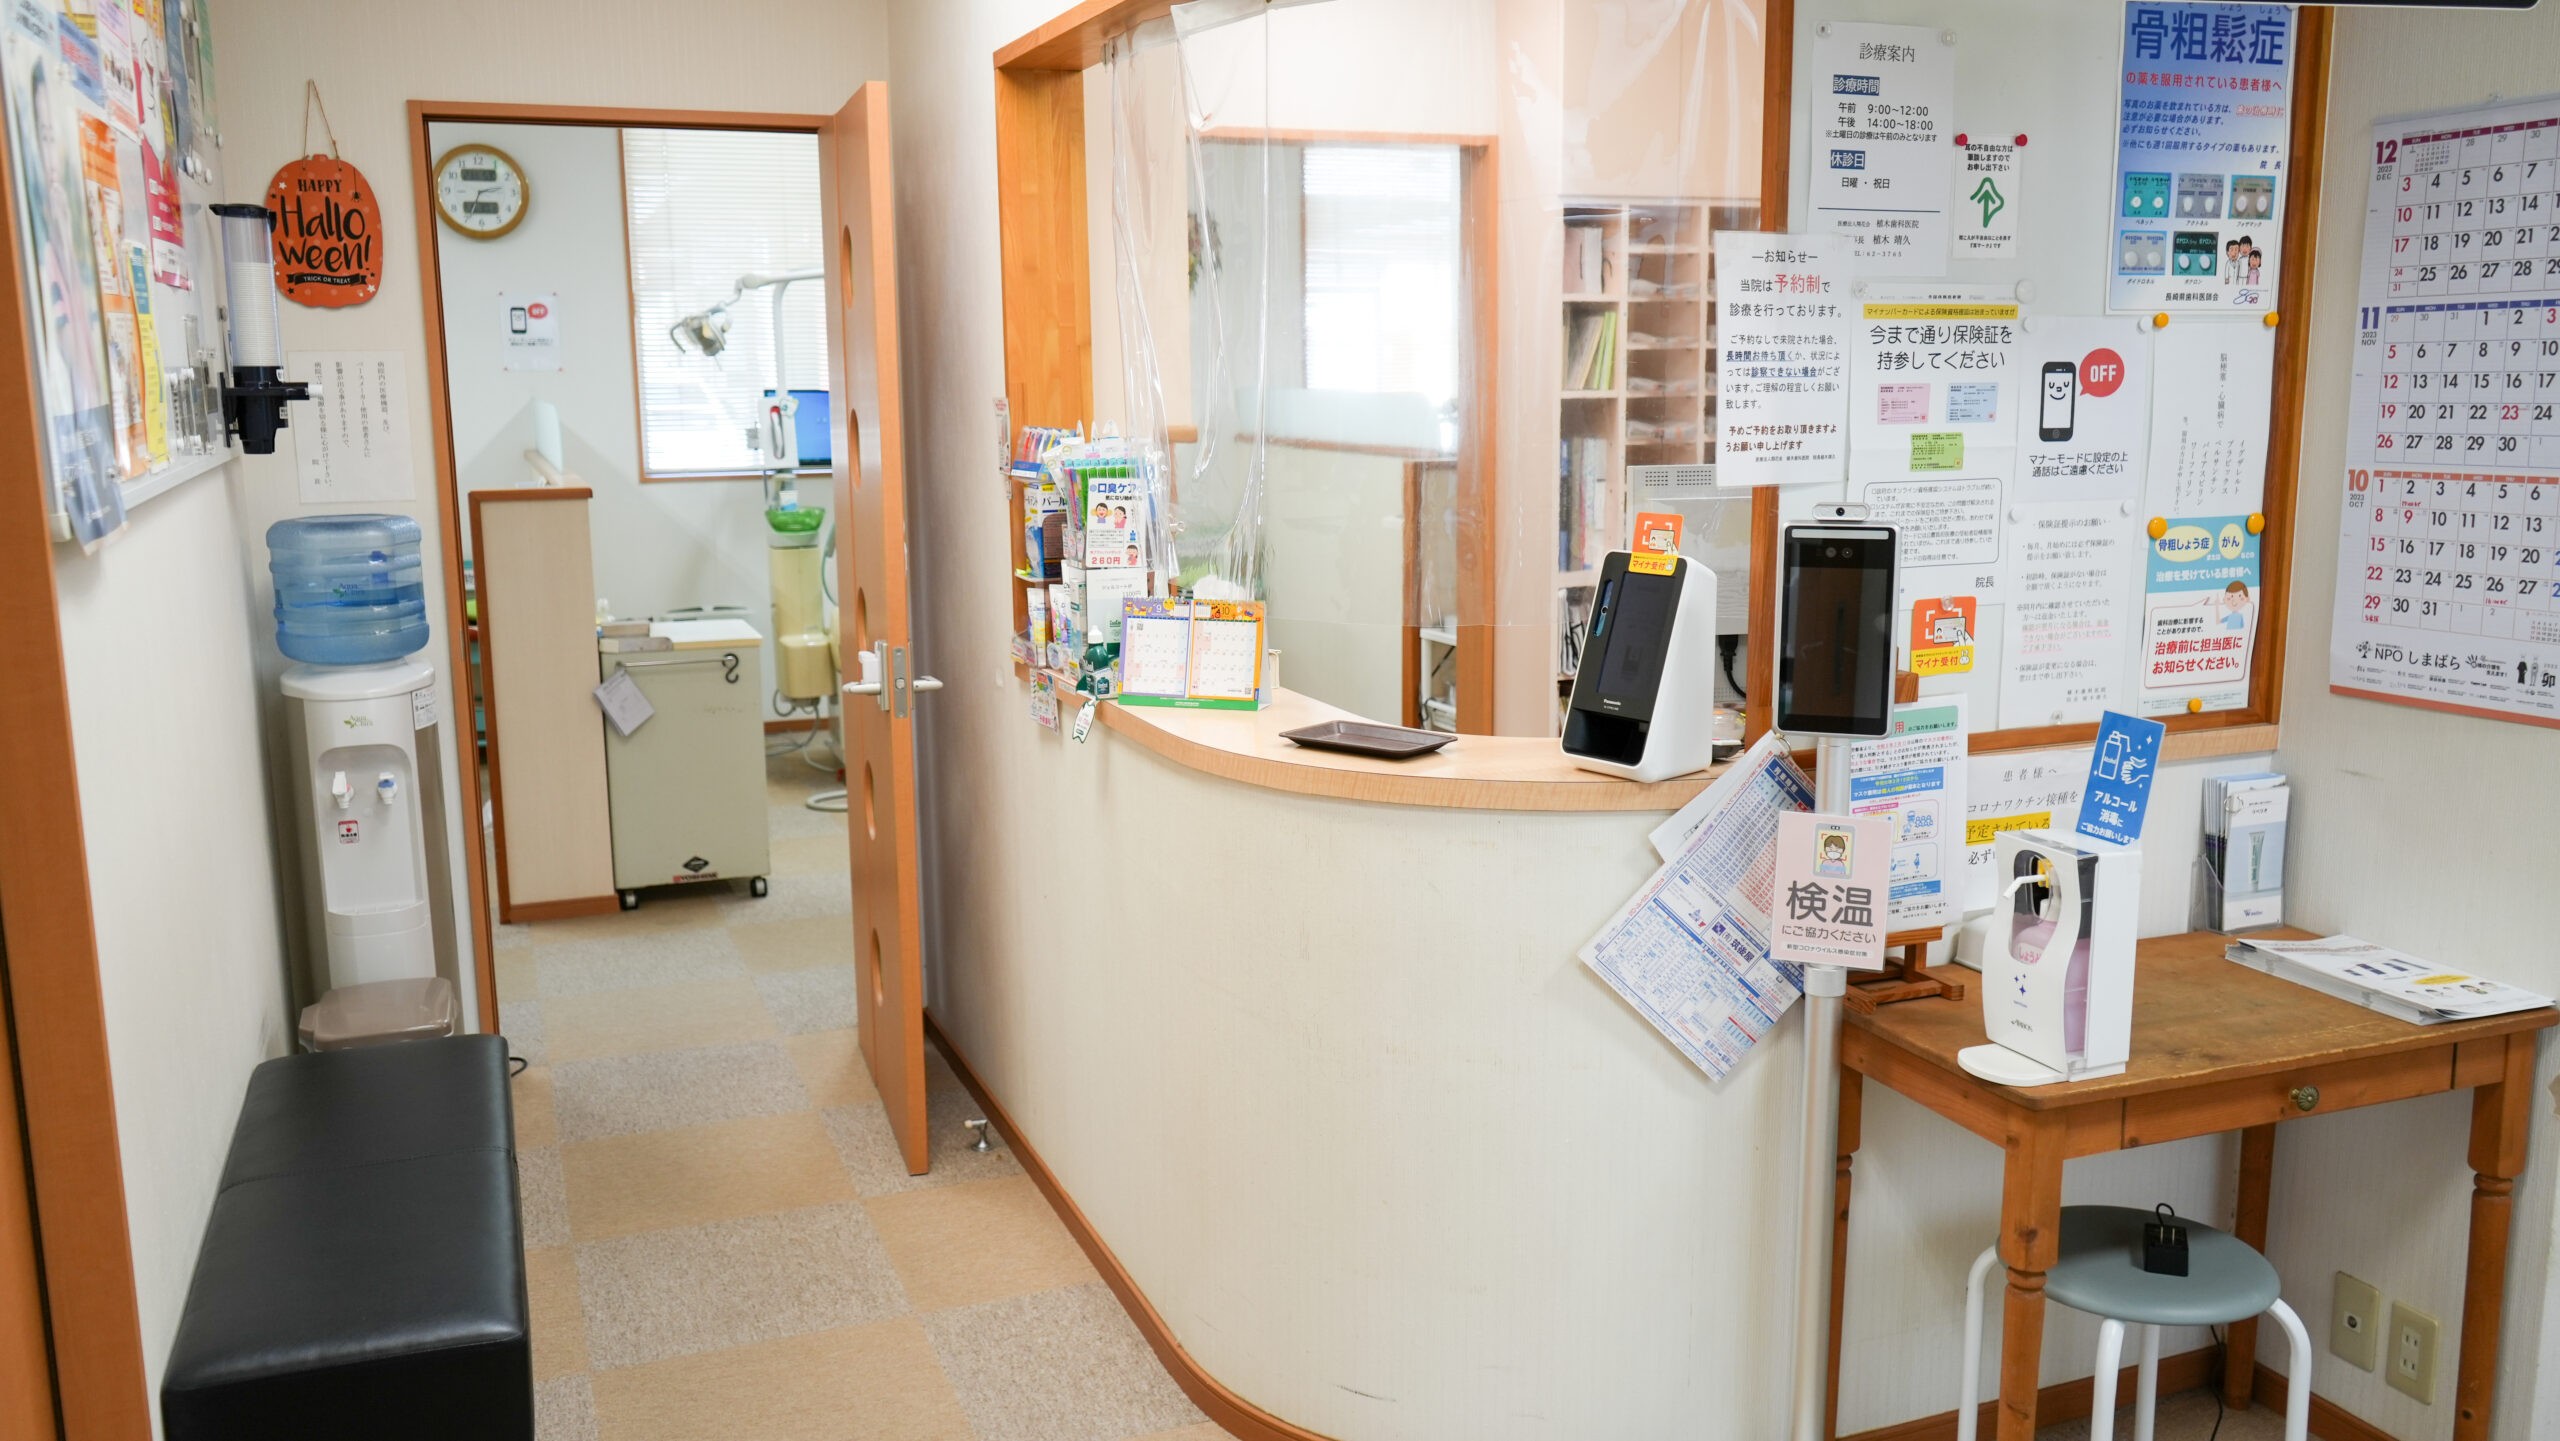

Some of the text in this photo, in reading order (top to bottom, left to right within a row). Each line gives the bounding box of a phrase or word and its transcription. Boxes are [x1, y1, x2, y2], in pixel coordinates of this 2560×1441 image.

[2131, 9, 2286, 65] 骨粗鬆症
[1859, 42, 1915, 63] 診療案内
[1833, 76, 1880, 95] 診療時間
[2126, 71, 2283, 92] の薬を服用されている患者様へ
[1838, 102, 1856, 114] 午前
[1837, 116, 1856, 128] 午後
[2122, 124, 2202, 136] 必ずお知らせください。
[1965, 143, 2013, 153] 耳の不自由な方は
[2376, 139, 2398, 165] 12
[1831, 151, 1865, 168] 休診日
[1967, 153, 2010, 162] 筆談しますので
[1967, 163, 2010, 172] お申し出下さい
[2377, 165, 2392, 173] 2023
[297, 179, 342, 192] HAPPY
[2402, 177, 2411, 191] 3
[280, 195, 365, 241] Hallo
[278, 235, 371, 272] ween!
[1740, 274, 1830, 294] 当院は予約制で
[2165, 292, 2219, 302] 長崎県歯科医師会
[1729, 303, 1842, 318] 診療を行っております。
[2362, 307, 2380, 329] 11
[2483, 311, 2488, 325] 1
[1870, 324, 2012, 345] 今まで通り保険証を
[1726, 351, 1840, 362] 長時間お待ち頂くか、状況によ
[1877, 351, 2005, 371] 持参してください
[1727, 367, 1840, 377] っては診察できない場合がござ
[2090, 364, 2117, 382] OFF
[1725, 399, 1762, 409] 致します。
[1729, 424, 1837, 436] 予めご予約をお取り頂きますよ
[1725, 440, 1803, 453] うお願い申し上げます
[2029, 452, 2128, 464] マナーモードに設定の上
[2032, 464, 2124, 477] 通話はご遠慮ください
[2348, 469, 2369, 492] 10
[2379, 479, 2540, 500] 1 2 3 4 5 6
[2375, 508, 2542, 532] 8 9 10 11 12 13
[2158, 537, 2211, 552] 骨粗しょう症
[2221, 536, 2240, 549] がん
[2371, 537, 2540, 563] 15 16 17 18 19 20
[1632, 559, 1667, 571] マイナ受付
[1975, 576, 1994, 588] 院長
[2156, 566, 2252, 583] 治療を受けている患者様へ
[2367, 566, 2537, 595] 22 23 24 25 26 27
[1156, 604, 1162, 613] 9
[2364, 595, 2437, 616] 29 30 31
[2154, 636, 2243, 656] 治療前に担当医に
[1915, 656, 1959, 669] マイナ受付
[2152, 656, 2240, 674] お知らせください。
[2374, 647, 2461, 671] NPO しまばら
[2094, 790, 2138, 813] アルコール
[2098, 808, 2124, 828] 消毒に
[1786, 880, 1874, 927] 検温
[1782, 924, 1877, 944] にご協力ください
[1786, 943, 1868, 958] 新型コロナウイルス感染症対策
